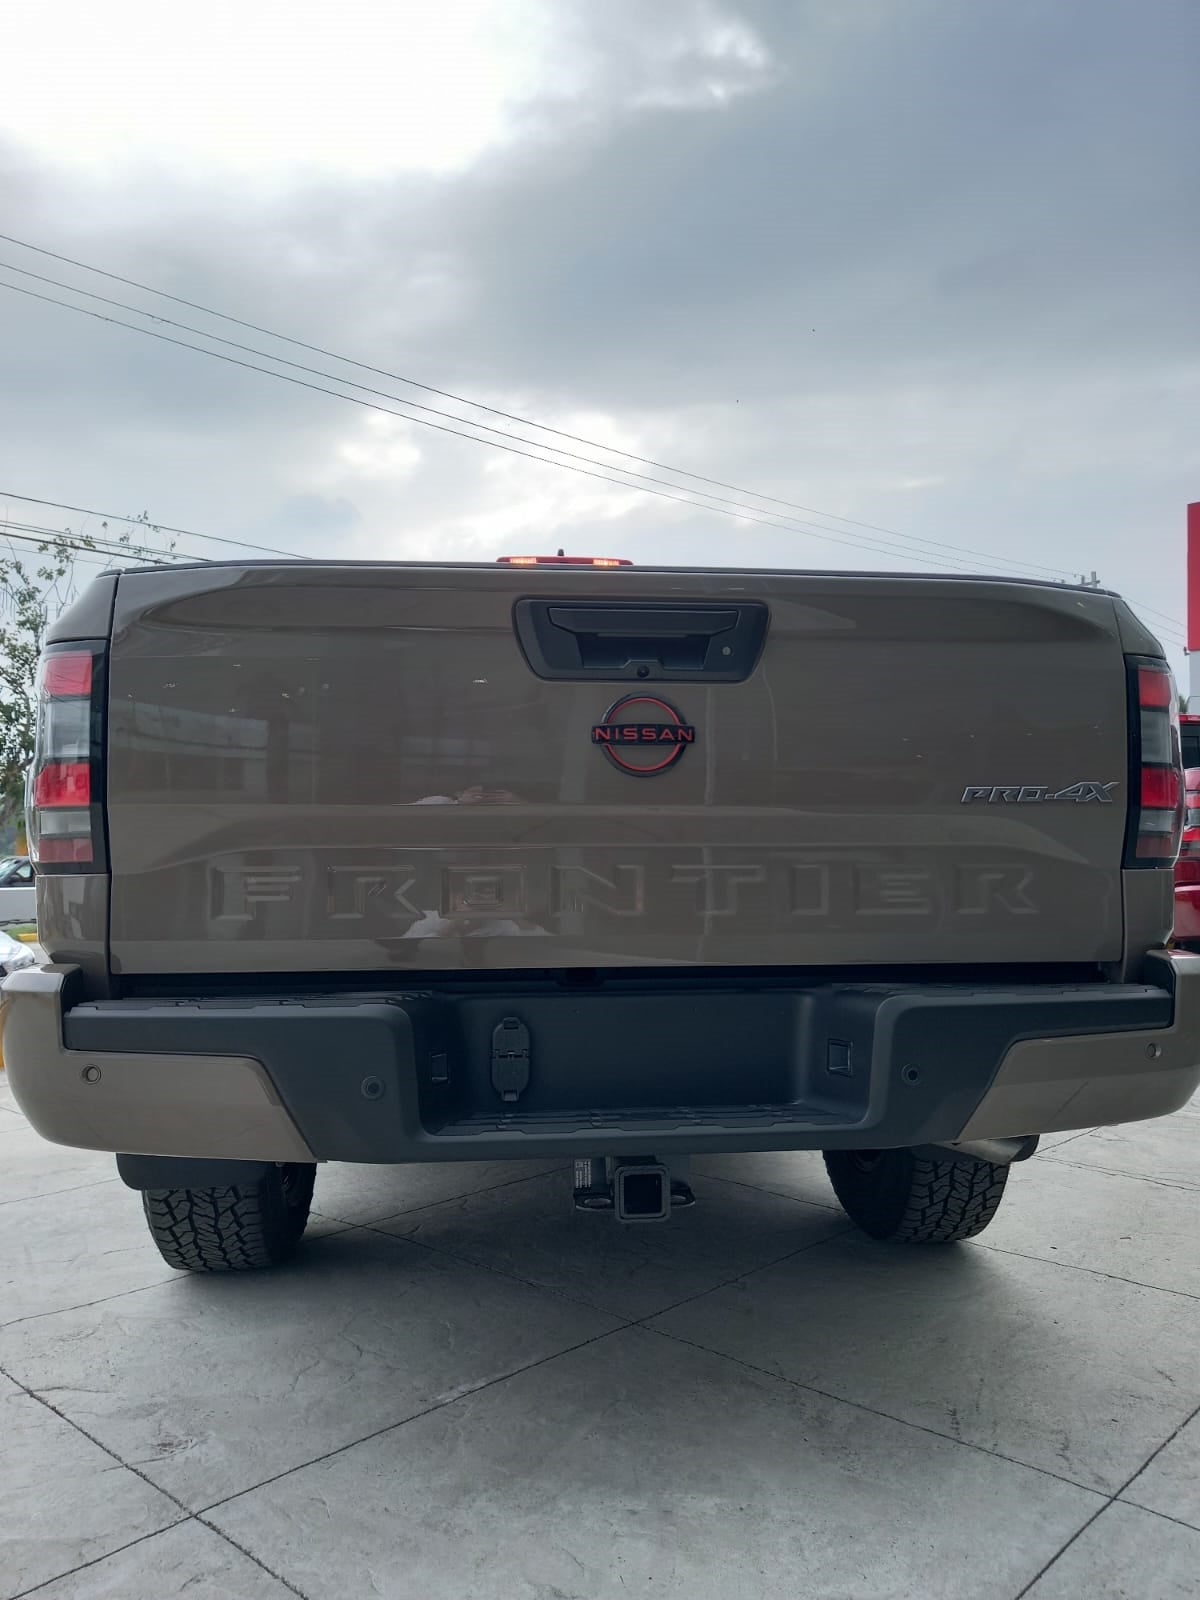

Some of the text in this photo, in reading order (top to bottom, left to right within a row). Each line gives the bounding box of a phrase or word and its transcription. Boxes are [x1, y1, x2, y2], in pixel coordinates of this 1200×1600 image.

[594, 727, 692, 741] NISSAN
[961, 782, 1120, 803] PRO-4X
[208, 863, 1039, 921] FRONTIER
